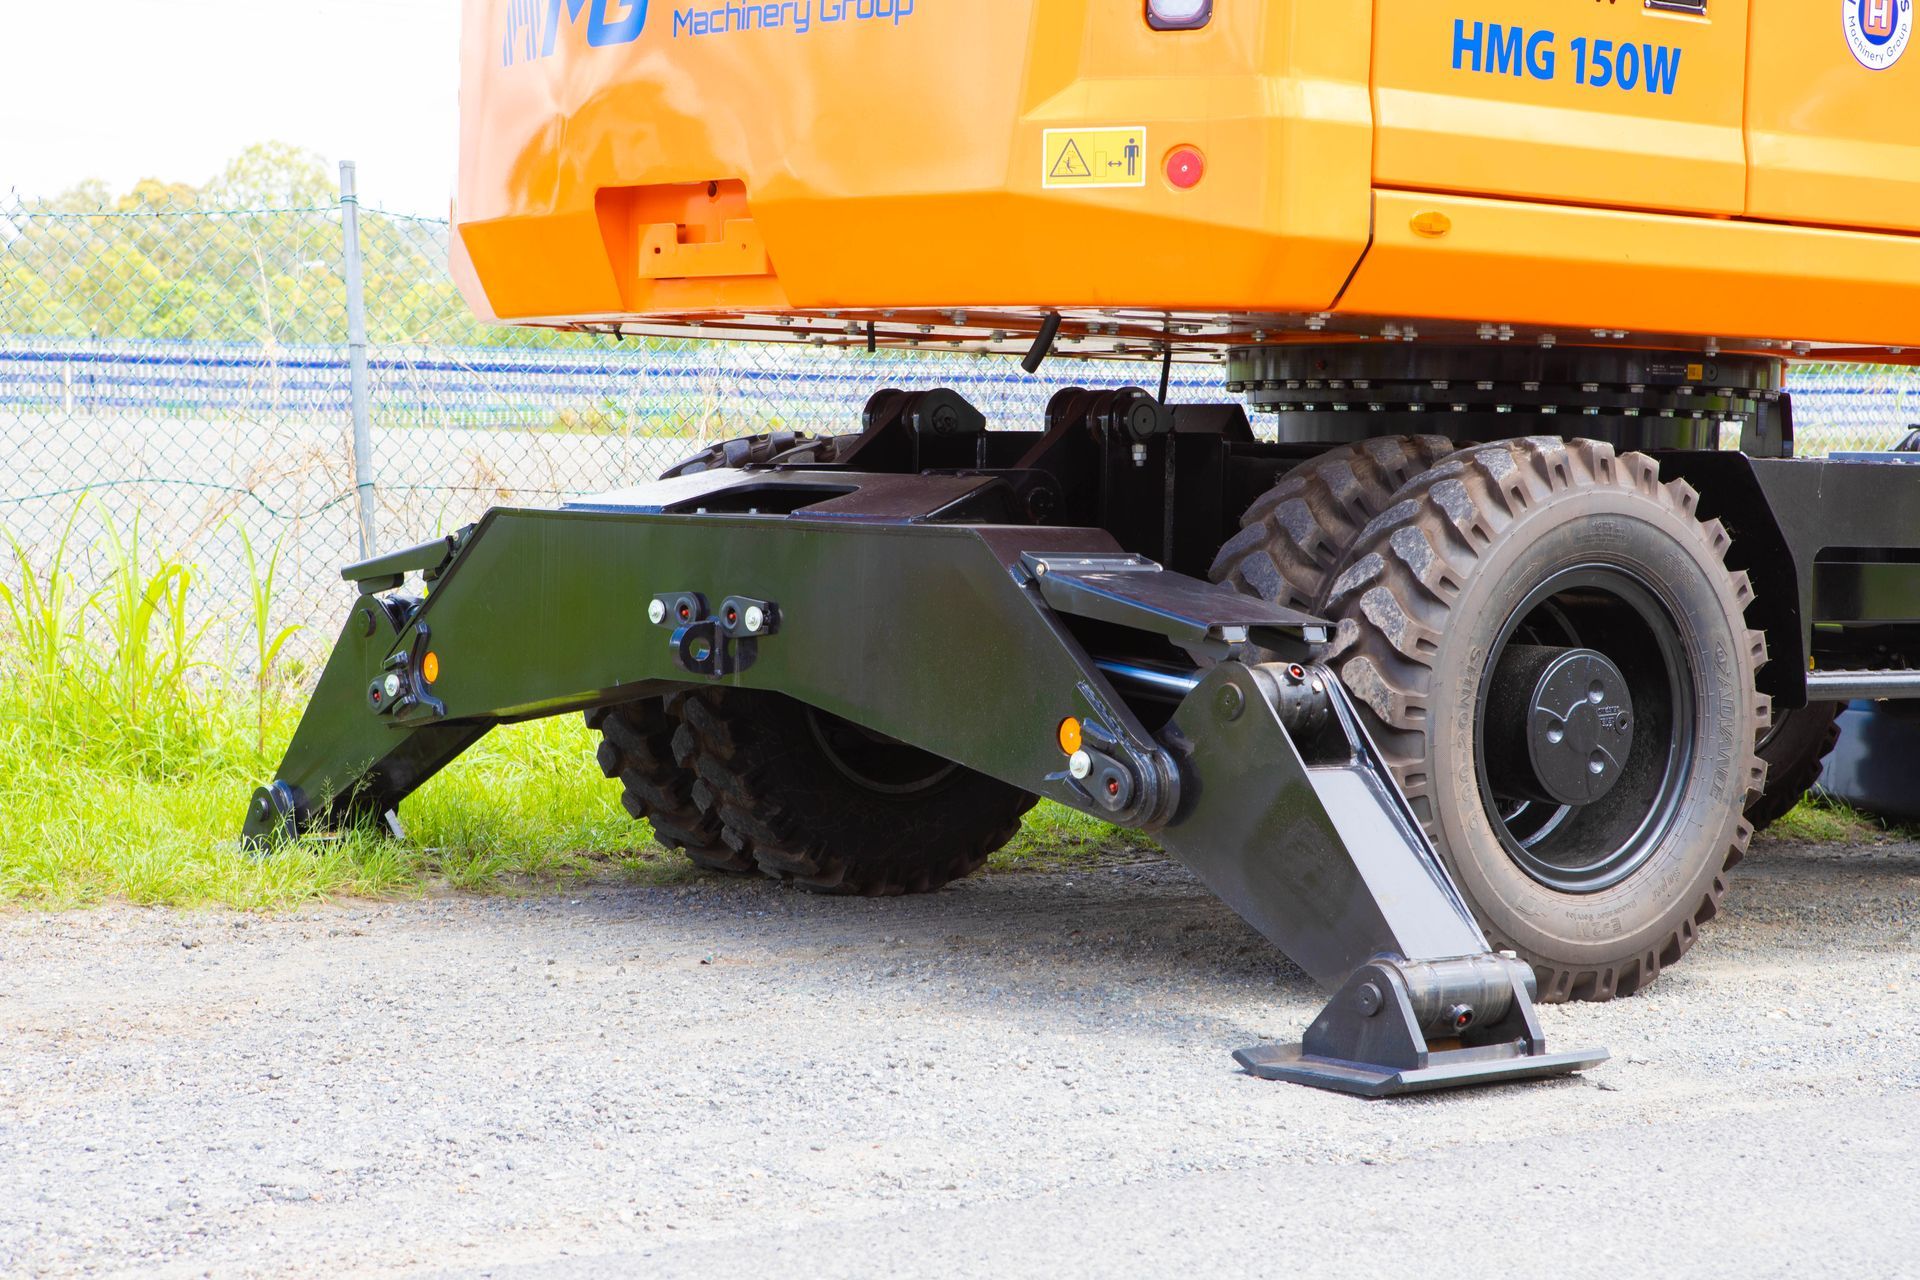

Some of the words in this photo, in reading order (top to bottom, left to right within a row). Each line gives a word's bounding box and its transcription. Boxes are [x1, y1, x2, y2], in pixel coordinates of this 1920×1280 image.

[673, 0, 811, 38] Machinery
[819, 0, 914, 26] Group
[1848, 15, 1884, 64] Machinery
[1886, 23, 1908, 58] Group
[1452, 18, 1555, 81] HMG
[1570, 37, 1682, 95] 150W
